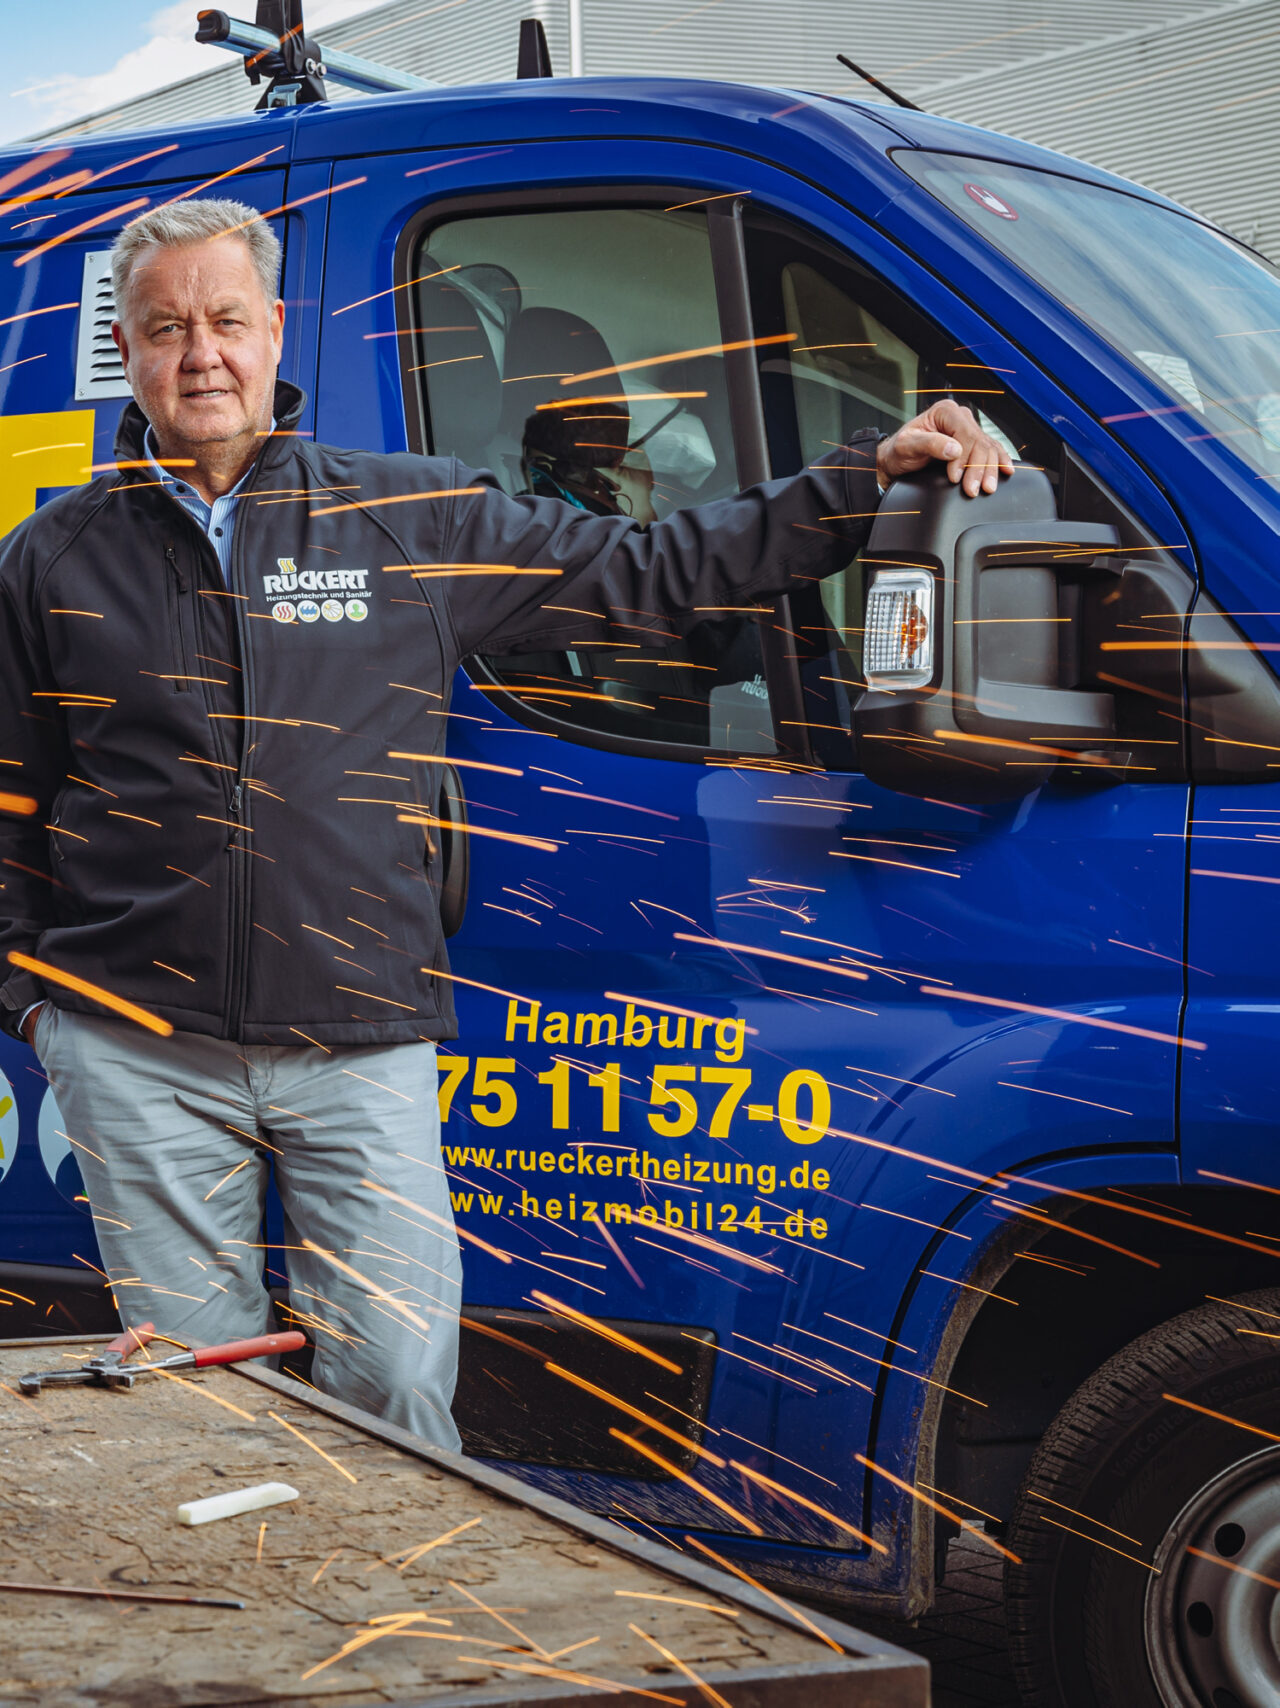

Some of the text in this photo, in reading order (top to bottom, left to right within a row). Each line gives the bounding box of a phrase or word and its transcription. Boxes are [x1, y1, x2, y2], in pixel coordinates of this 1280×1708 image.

[263, 566, 369, 595] RÜCKERT
[266, 592, 328, 602] Heizungstechnik
[345, 591, 372, 599] Sanitär
[505, 999, 746, 1063] Hamburg
[440, 1144, 831, 1195] ww.rueckertheizung.de
[1111, 1403, 1198, 1477] VanContac
